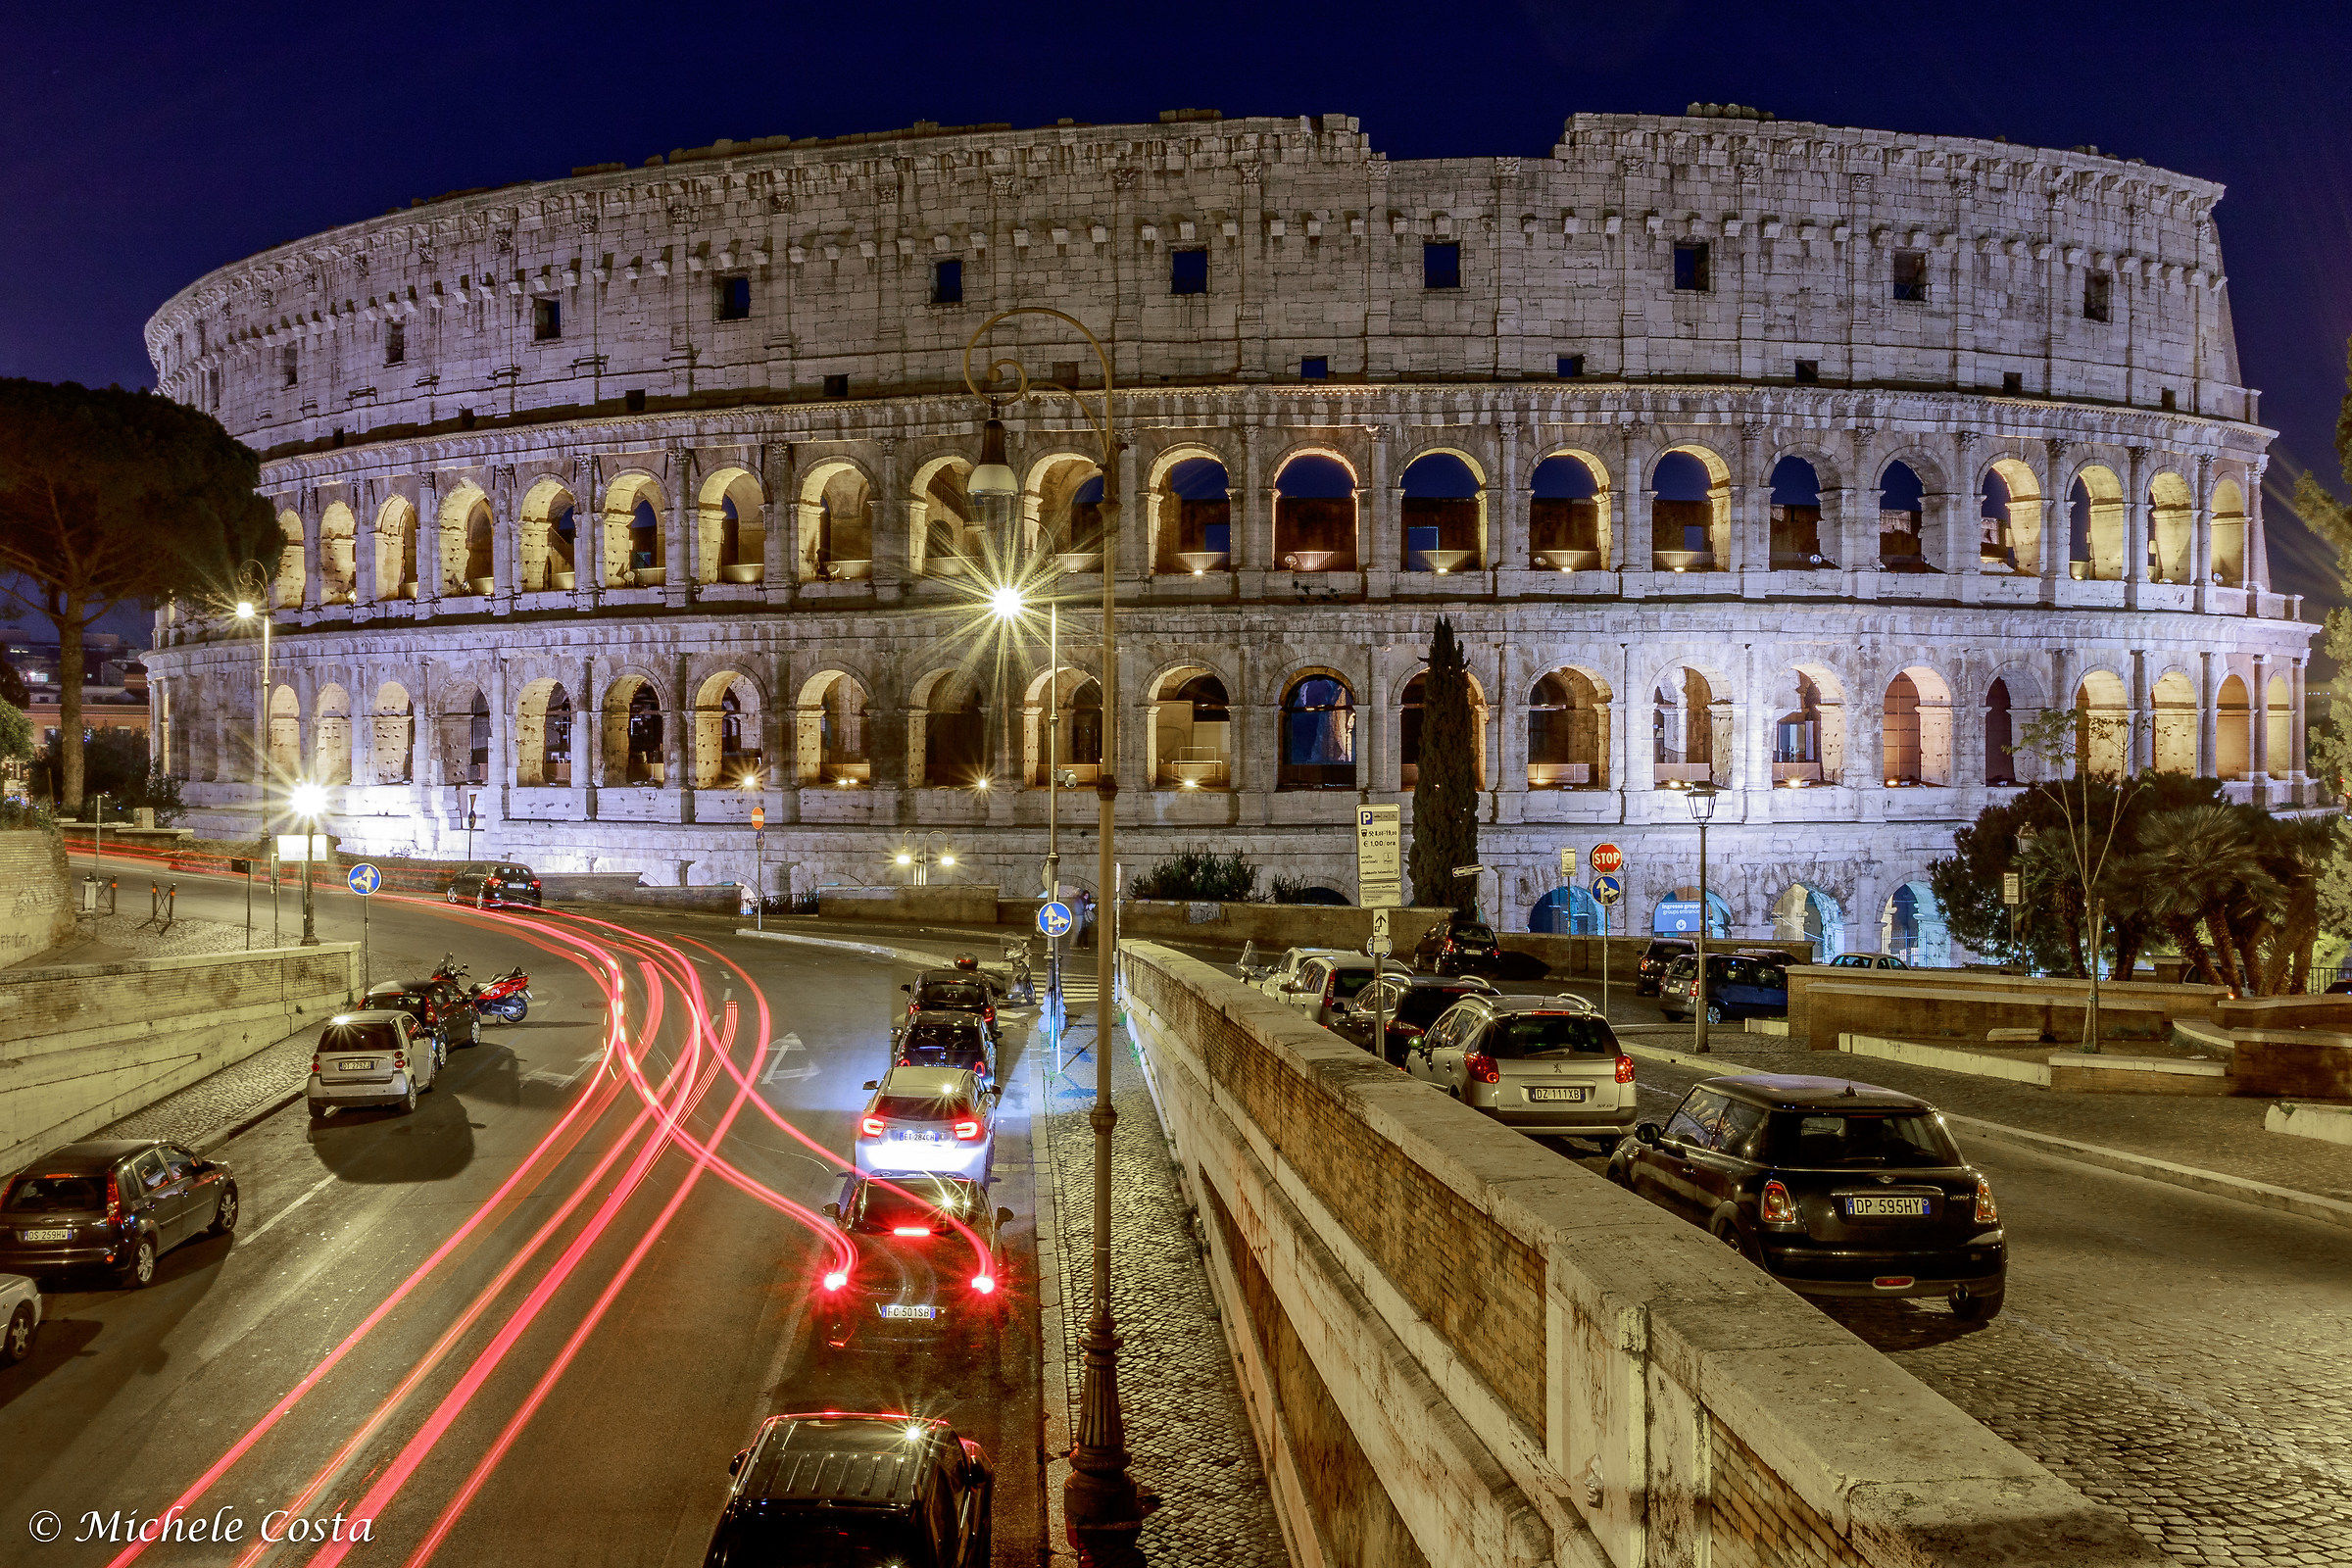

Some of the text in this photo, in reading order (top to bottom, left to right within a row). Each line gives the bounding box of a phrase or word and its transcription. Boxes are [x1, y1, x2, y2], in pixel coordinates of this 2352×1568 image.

[1362, 811, 1371, 824] P
[1594, 852, 1620, 864] STOP
[1536, 1089, 1581, 1099] DZ 111XB
[1856, 1199, 1873, 1213] DP
[1879, 1199, 1920, 1213] 595HY
[28, 1231, 67, 1240] DS 259HW
[887, 1307, 930, 1317] FC 501SB
